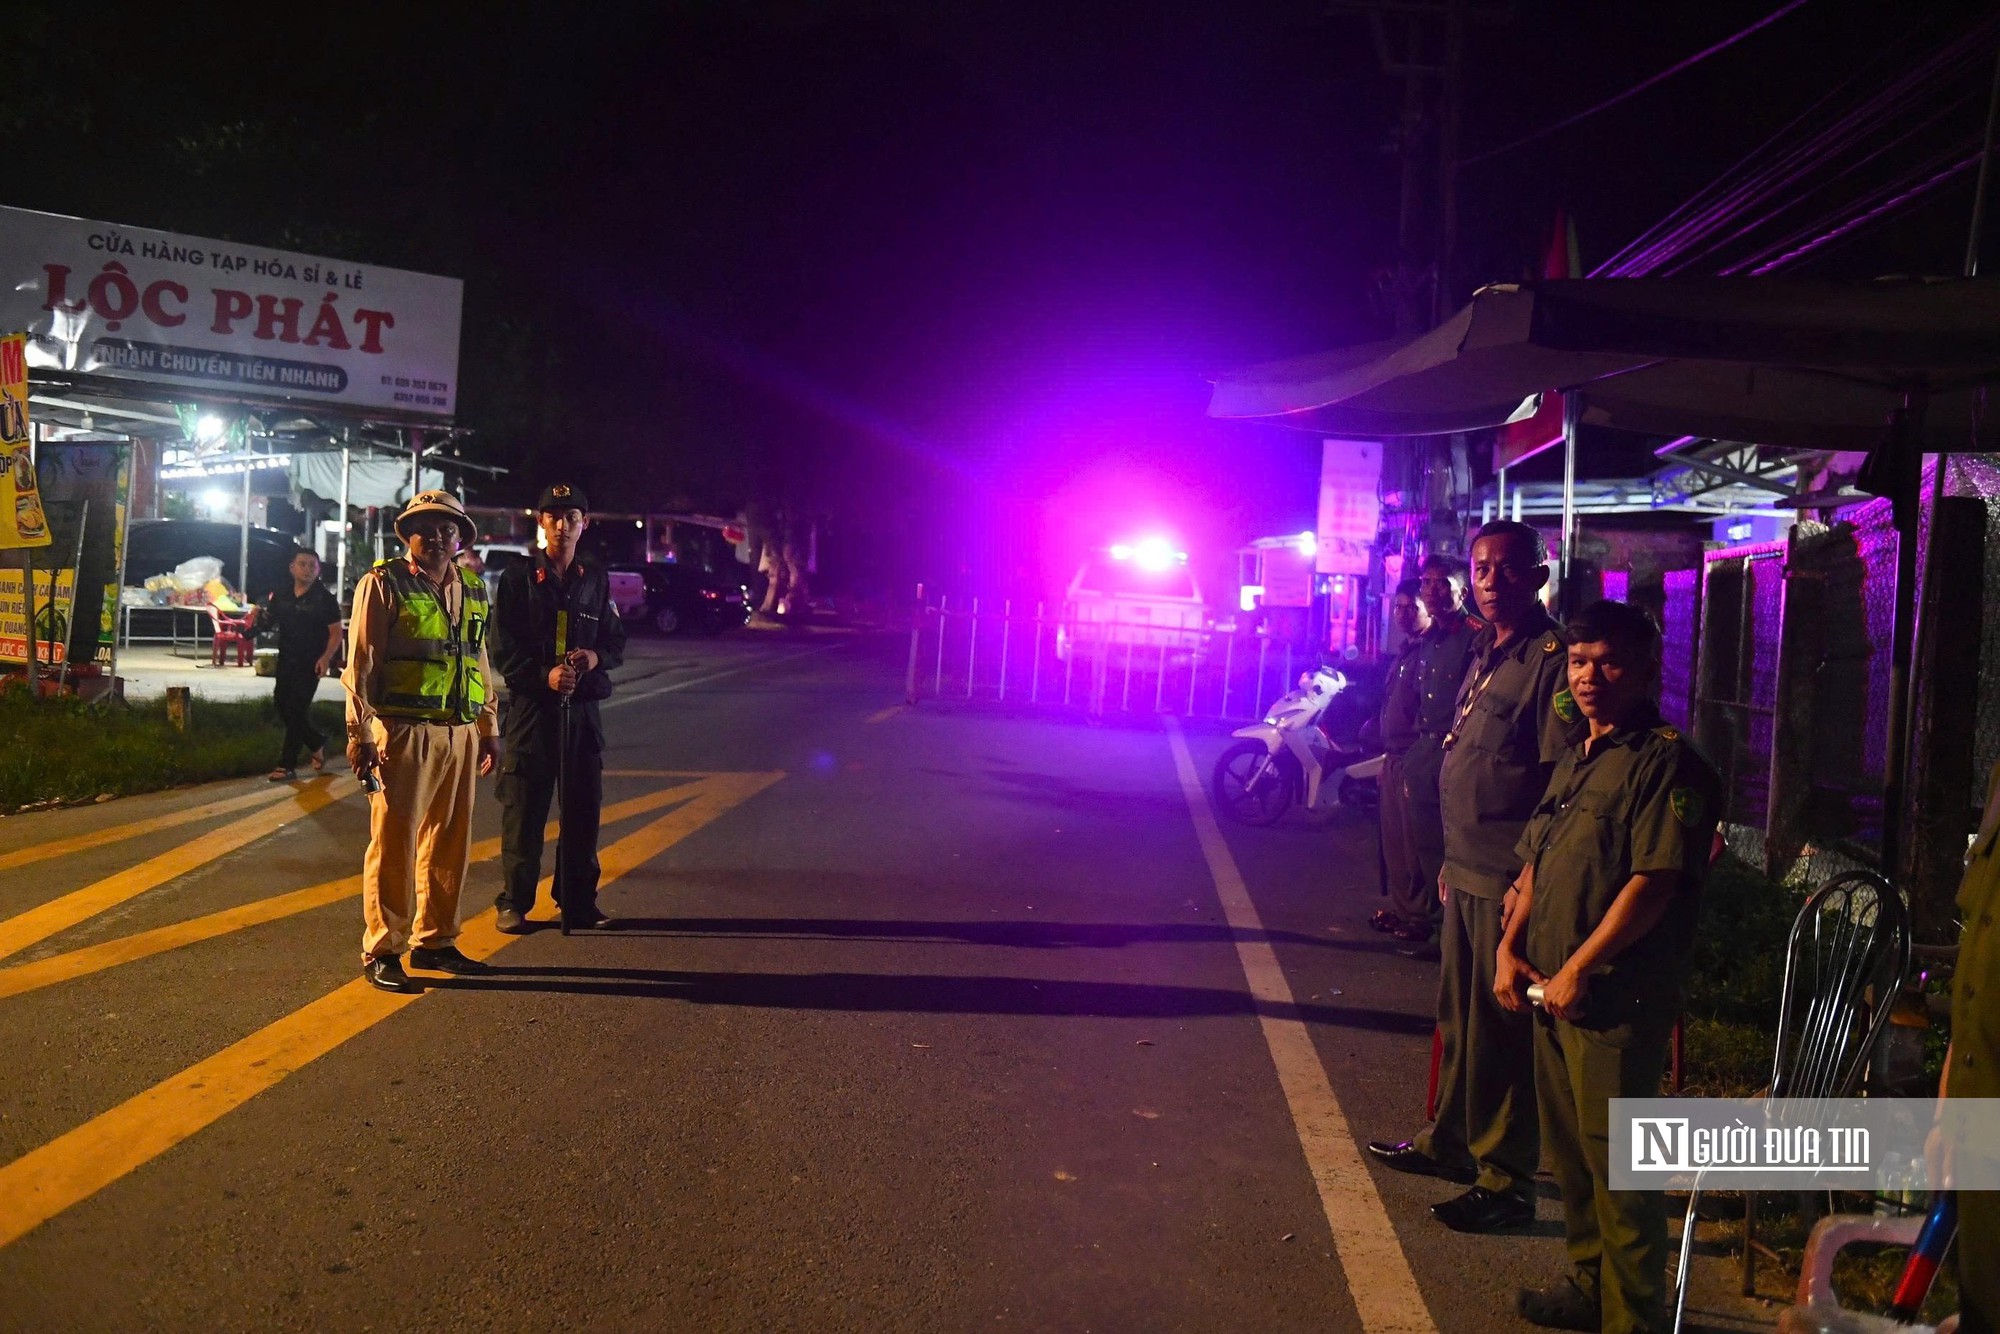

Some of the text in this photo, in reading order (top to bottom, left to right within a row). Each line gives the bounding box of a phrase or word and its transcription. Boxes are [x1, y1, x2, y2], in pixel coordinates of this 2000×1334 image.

[88, 231, 363, 289] CỬA HÀNG TẠP HÓA SỈ & LẺ
[41, 260, 395, 354] LỘC PHÁT
[160, 352, 232, 376] CHUYỂN
[280, 367, 340, 389] NHANH
